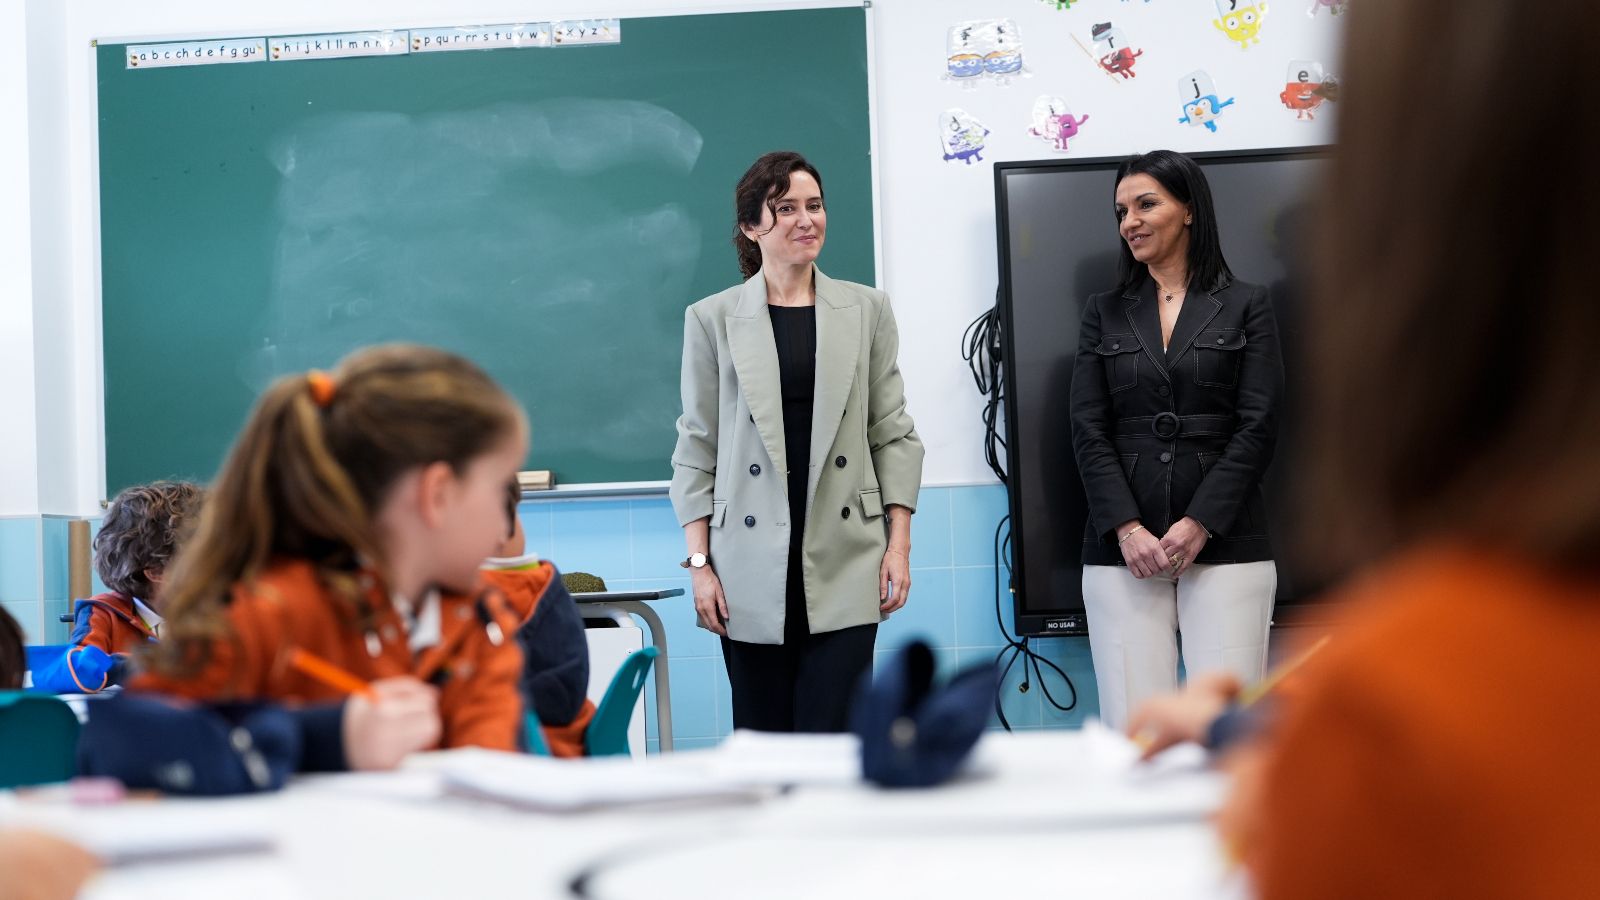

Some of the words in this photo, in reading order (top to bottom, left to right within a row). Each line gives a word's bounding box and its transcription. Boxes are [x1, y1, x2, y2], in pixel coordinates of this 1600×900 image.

[436, 35, 449, 45] qu
[465, 33, 478, 41] rr
[1107, 36, 1114, 48] r
[175, 48, 189, 58] ch
[242, 47, 256, 58] gu
[1297, 70, 1309, 83] e
[1191, 78, 1201, 99] j
